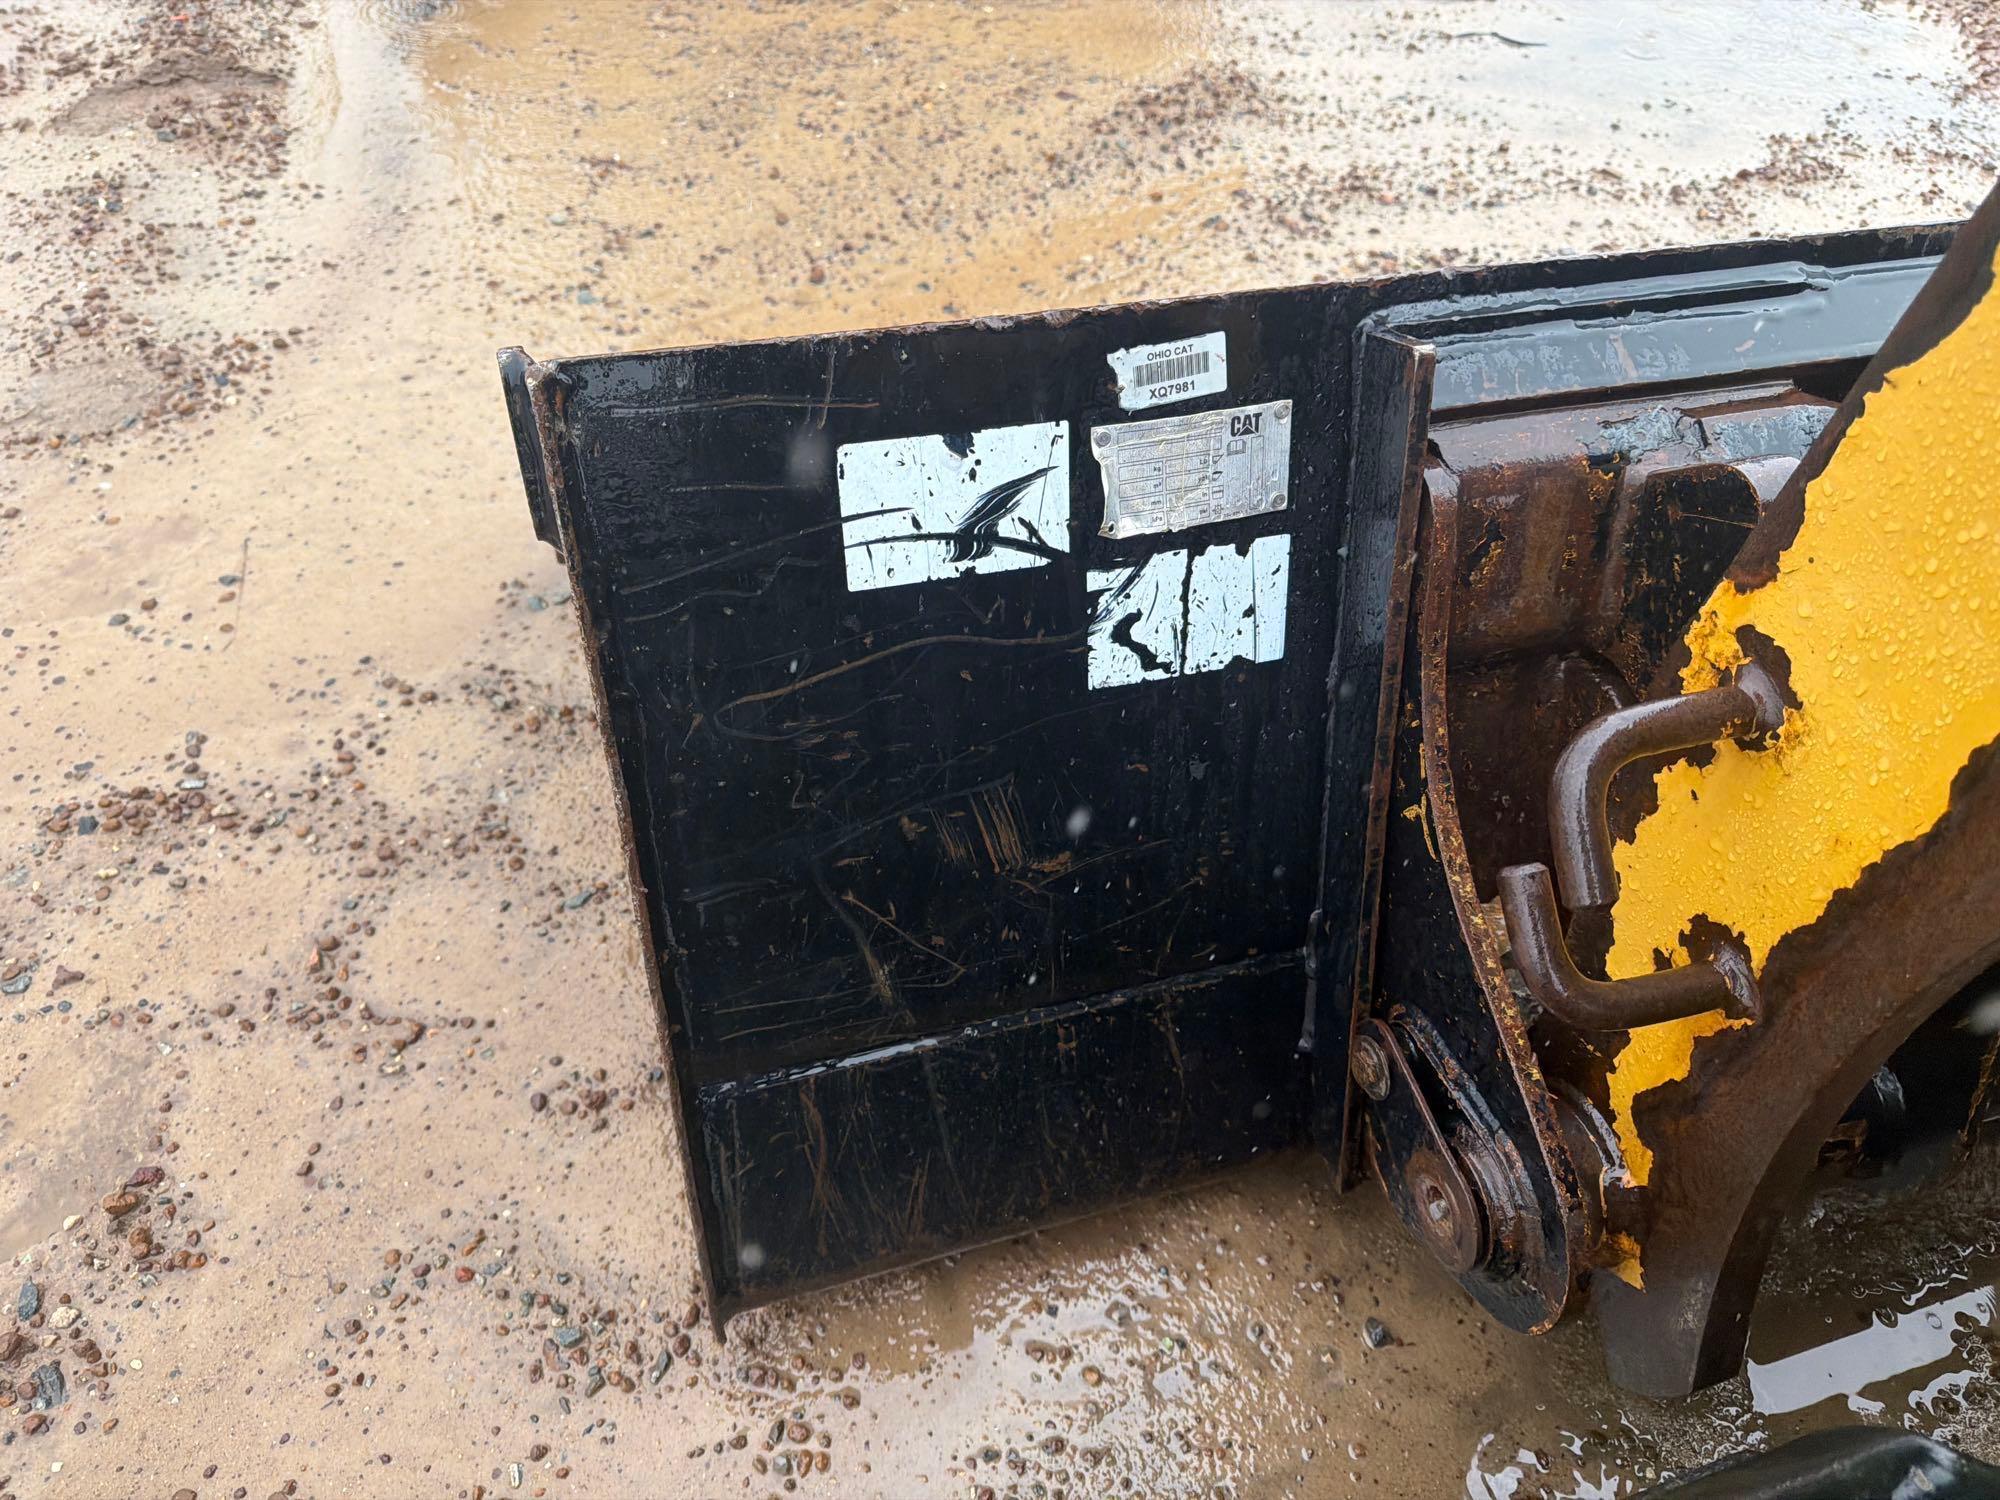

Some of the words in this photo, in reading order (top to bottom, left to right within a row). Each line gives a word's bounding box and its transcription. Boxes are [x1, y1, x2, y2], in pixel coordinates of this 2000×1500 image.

[1147, 348, 1171, 361] OHIO
[1174, 344, 1194, 356] CAT
[1149, 380, 1195, 399] XQ7981
[1231, 412, 1263, 437] CAT
